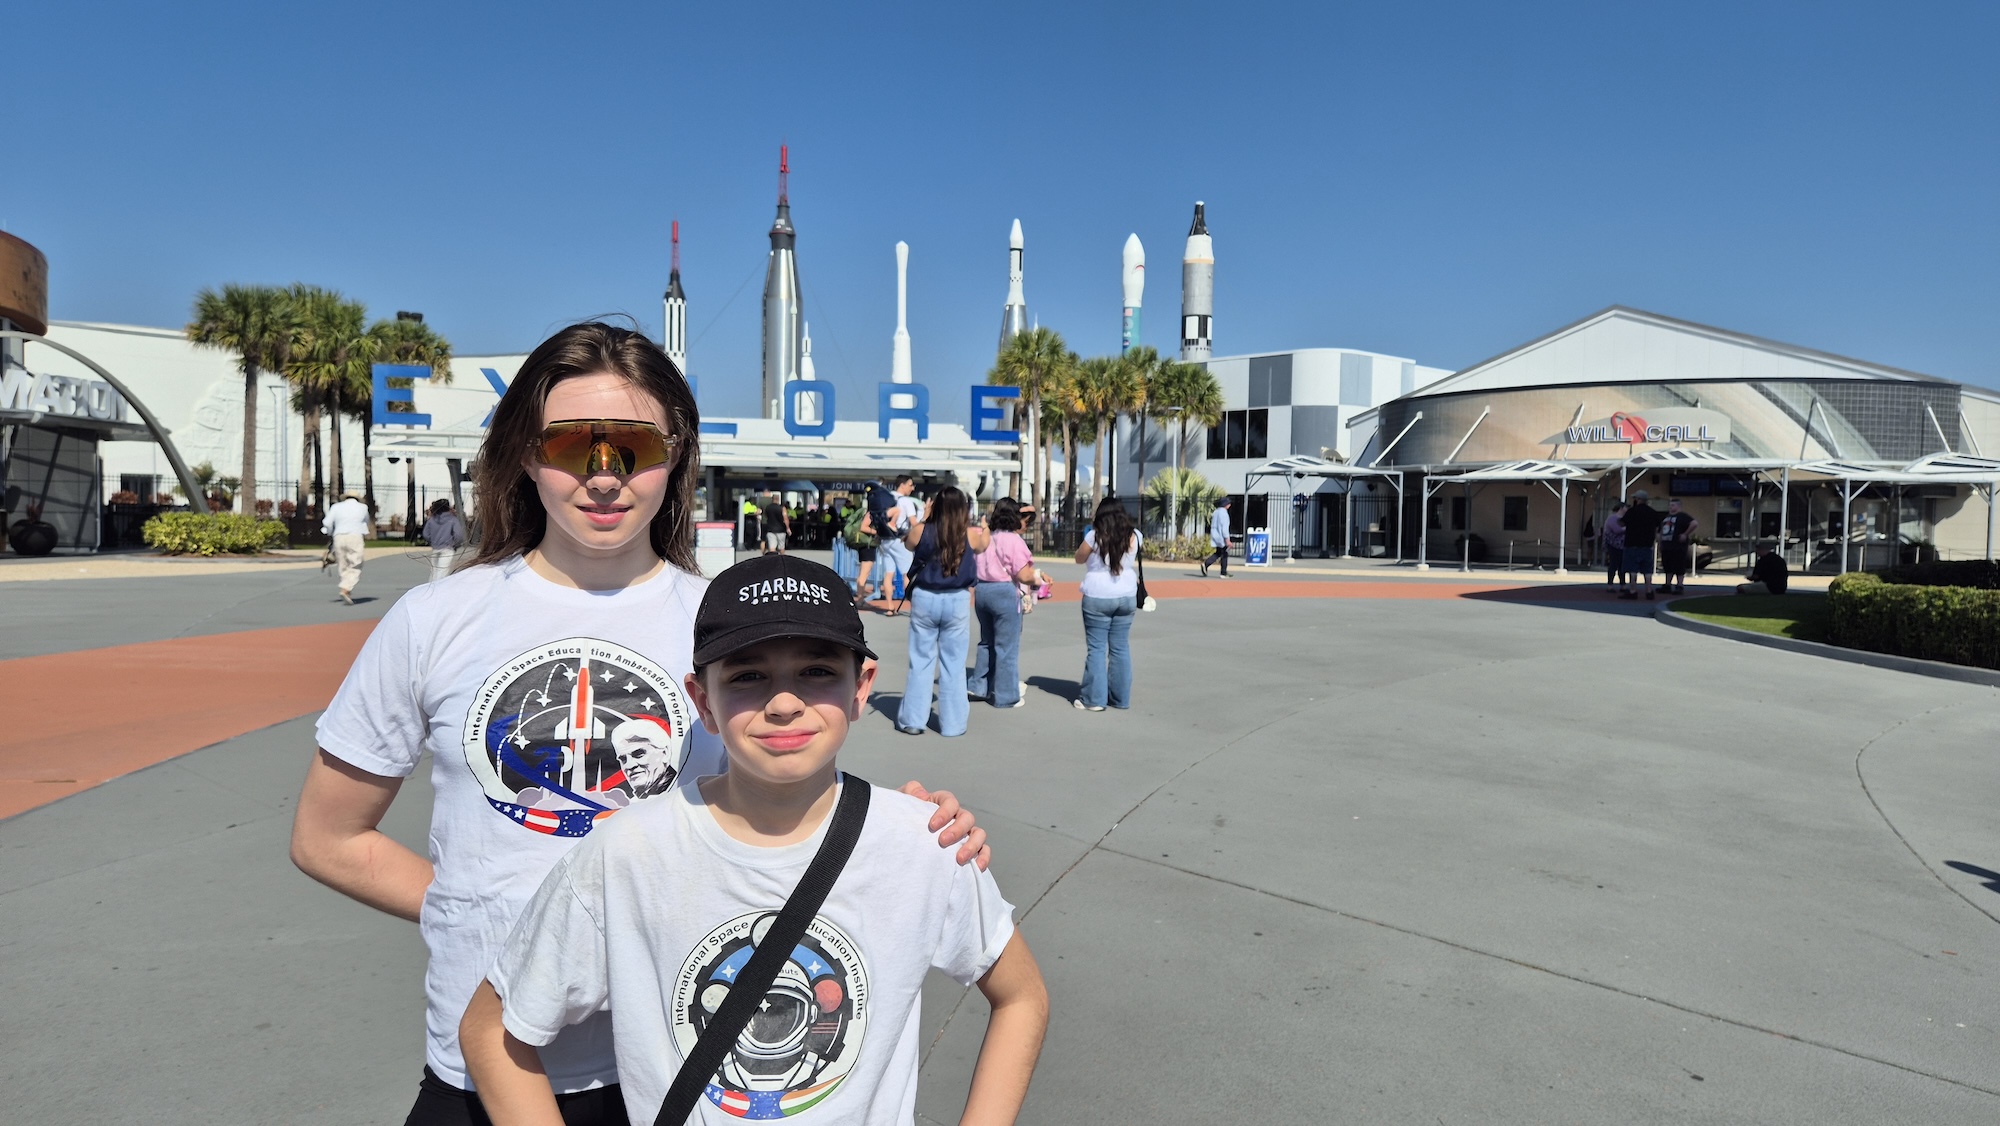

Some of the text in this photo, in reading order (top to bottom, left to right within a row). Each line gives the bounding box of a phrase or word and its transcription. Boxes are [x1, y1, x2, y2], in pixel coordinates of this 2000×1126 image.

[371, 363, 1020, 441] ELORE
[1568, 423, 1718, 442] WILL CALL
[831, 482, 855, 490] JOIN
[738, 576, 832, 604] STARBASE
[750, 593, 820, 605] BREWING
[470, 671, 511, 742] International
[512, 653, 545, 673] Space
[614, 653, 670, 692] Ambassador
[666, 691, 685, 738] Program
[675, 920, 868, 1026] International Space ducation Institute
